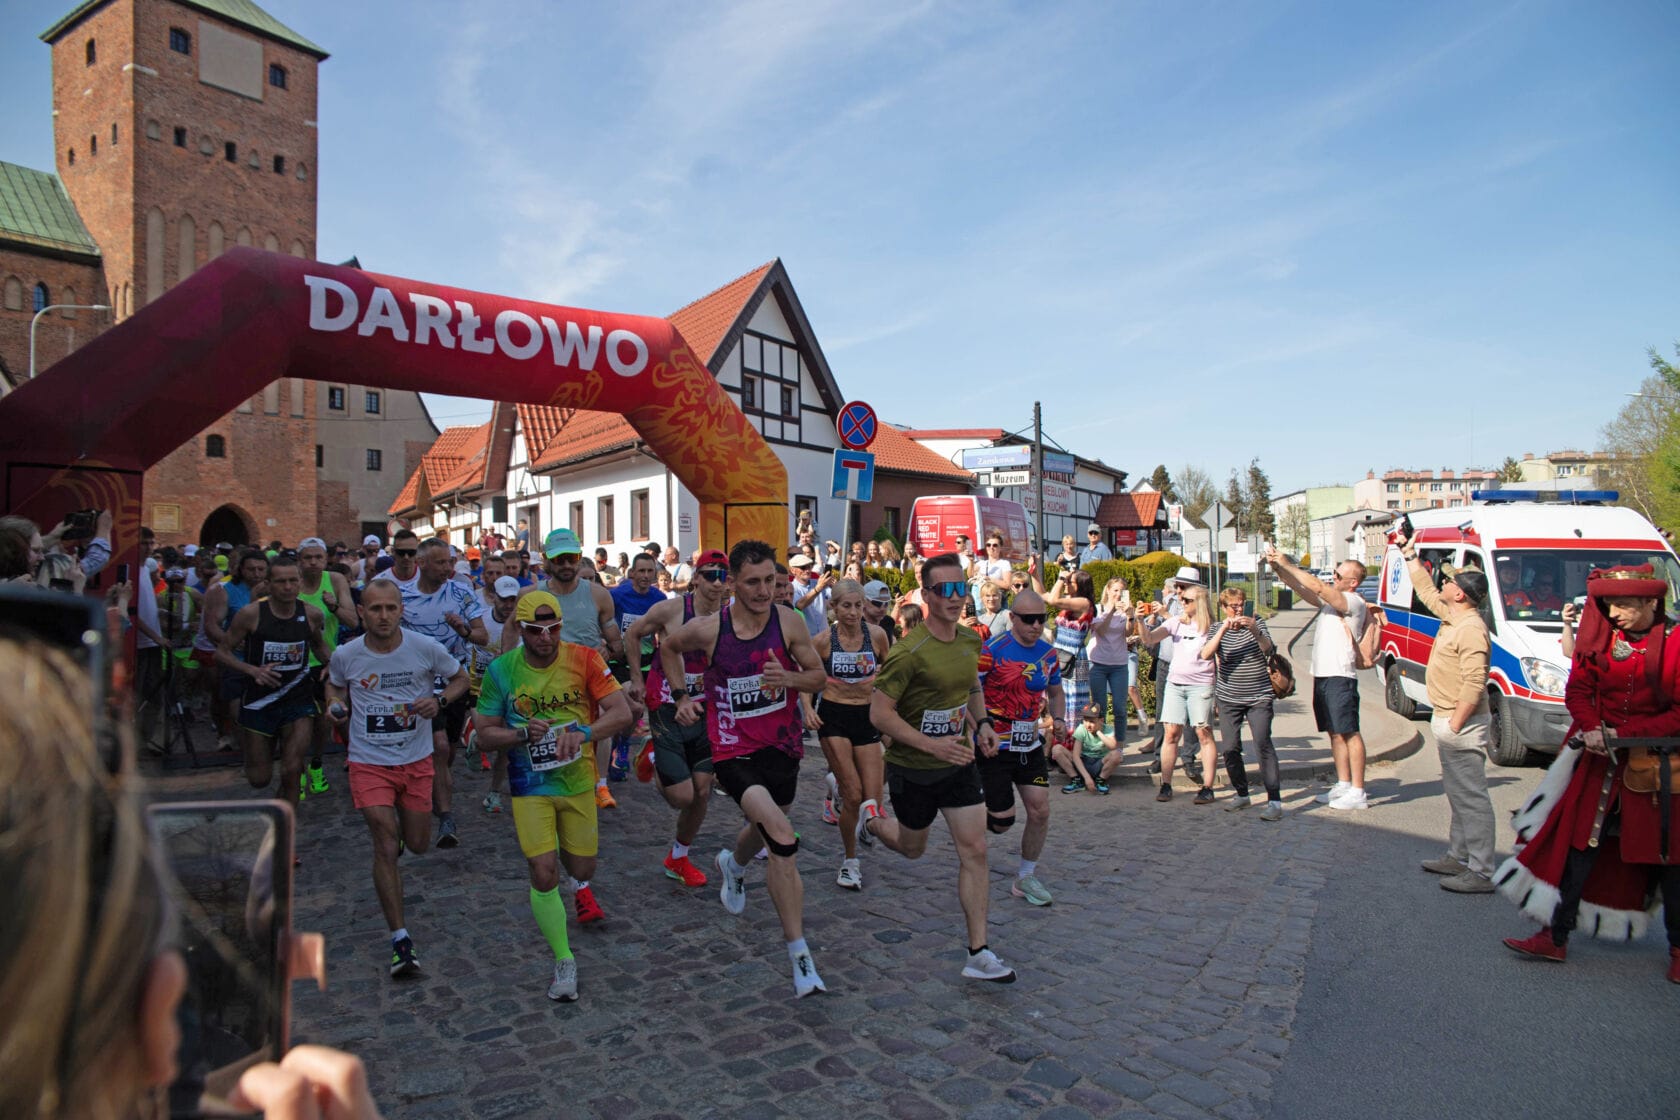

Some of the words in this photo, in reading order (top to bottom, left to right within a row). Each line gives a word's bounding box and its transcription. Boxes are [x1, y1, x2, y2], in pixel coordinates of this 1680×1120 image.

[303, 274, 649, 377] DARŁOWO
[994, 474, 1025, 484] Muzeum
[917, 531, 937, 539] WHITE
[265, 653, 287, 661] 155
[834, 664, 856, 673] 205
[729, 680, 760, 690] Eryka
[732, 691, 760, 705] 107
[366, 704, 394, 713] Eryka
[375, 716, 385, 727] 2
[923, 723, 949, 734] 230
[1013, 733, 1033, 742] 102
[530, 743, 557, 757] 255
